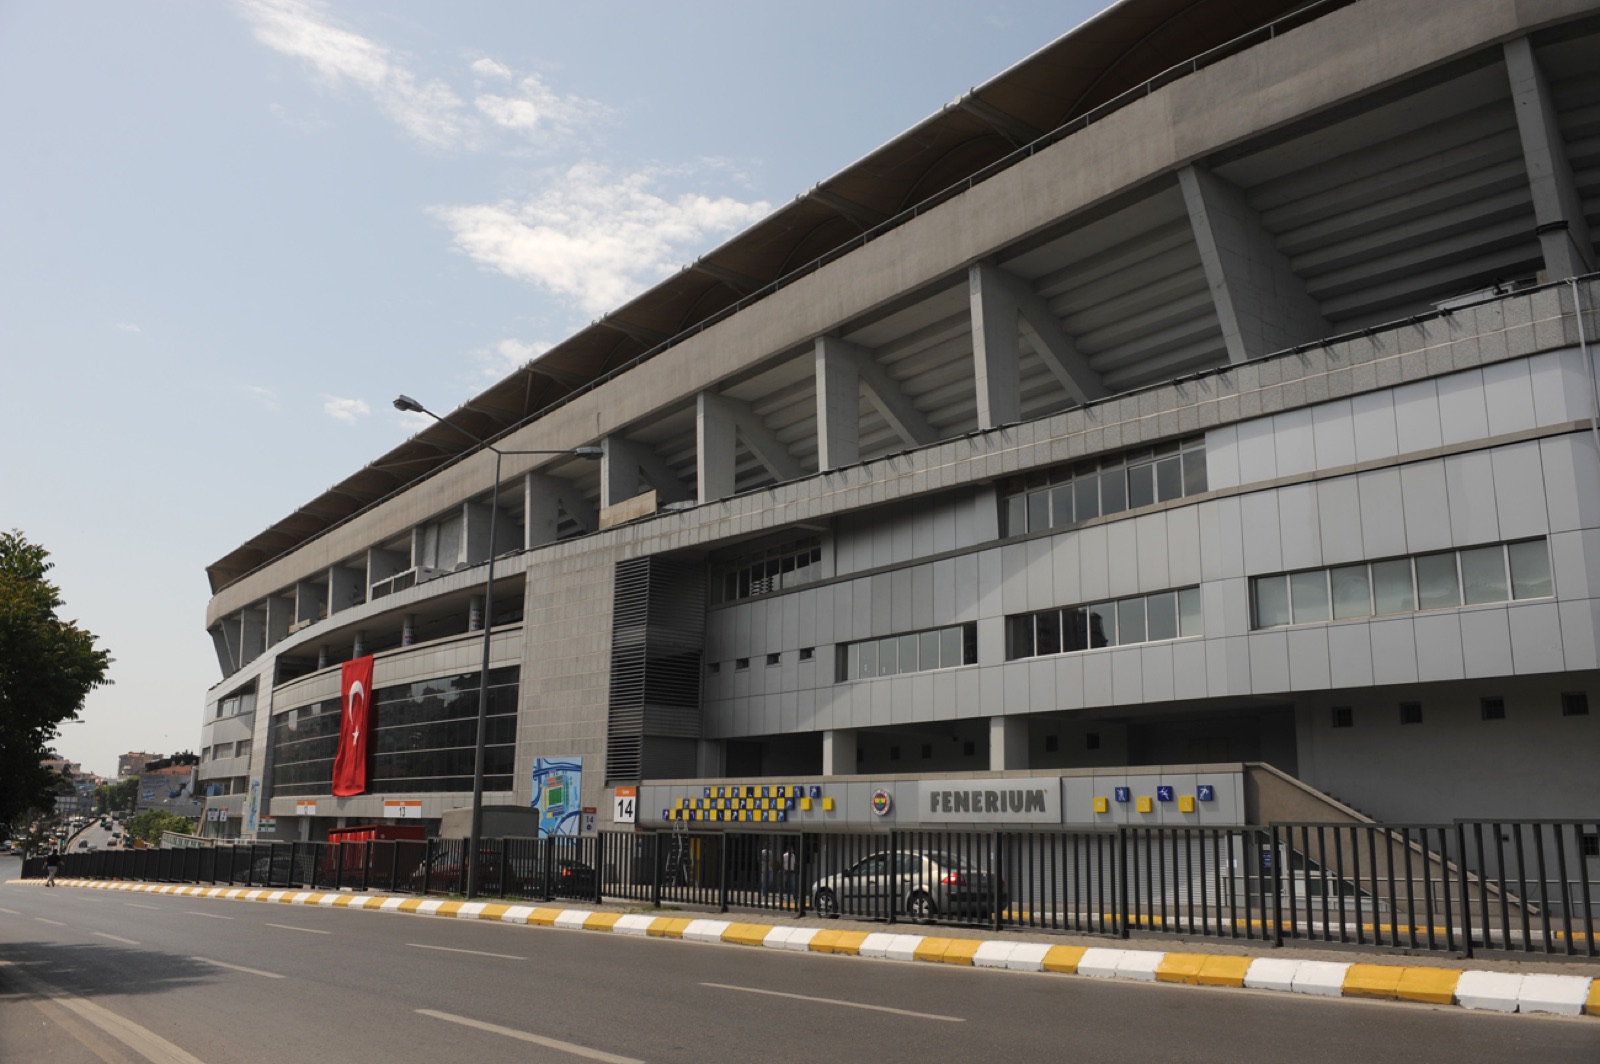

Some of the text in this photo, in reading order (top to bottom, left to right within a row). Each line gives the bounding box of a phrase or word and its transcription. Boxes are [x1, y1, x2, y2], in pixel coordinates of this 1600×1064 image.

[617, 798, 634, 818] 14
[930, 789, 1046, 813] FENERIUM
[586, 815, 594, 824] 14
